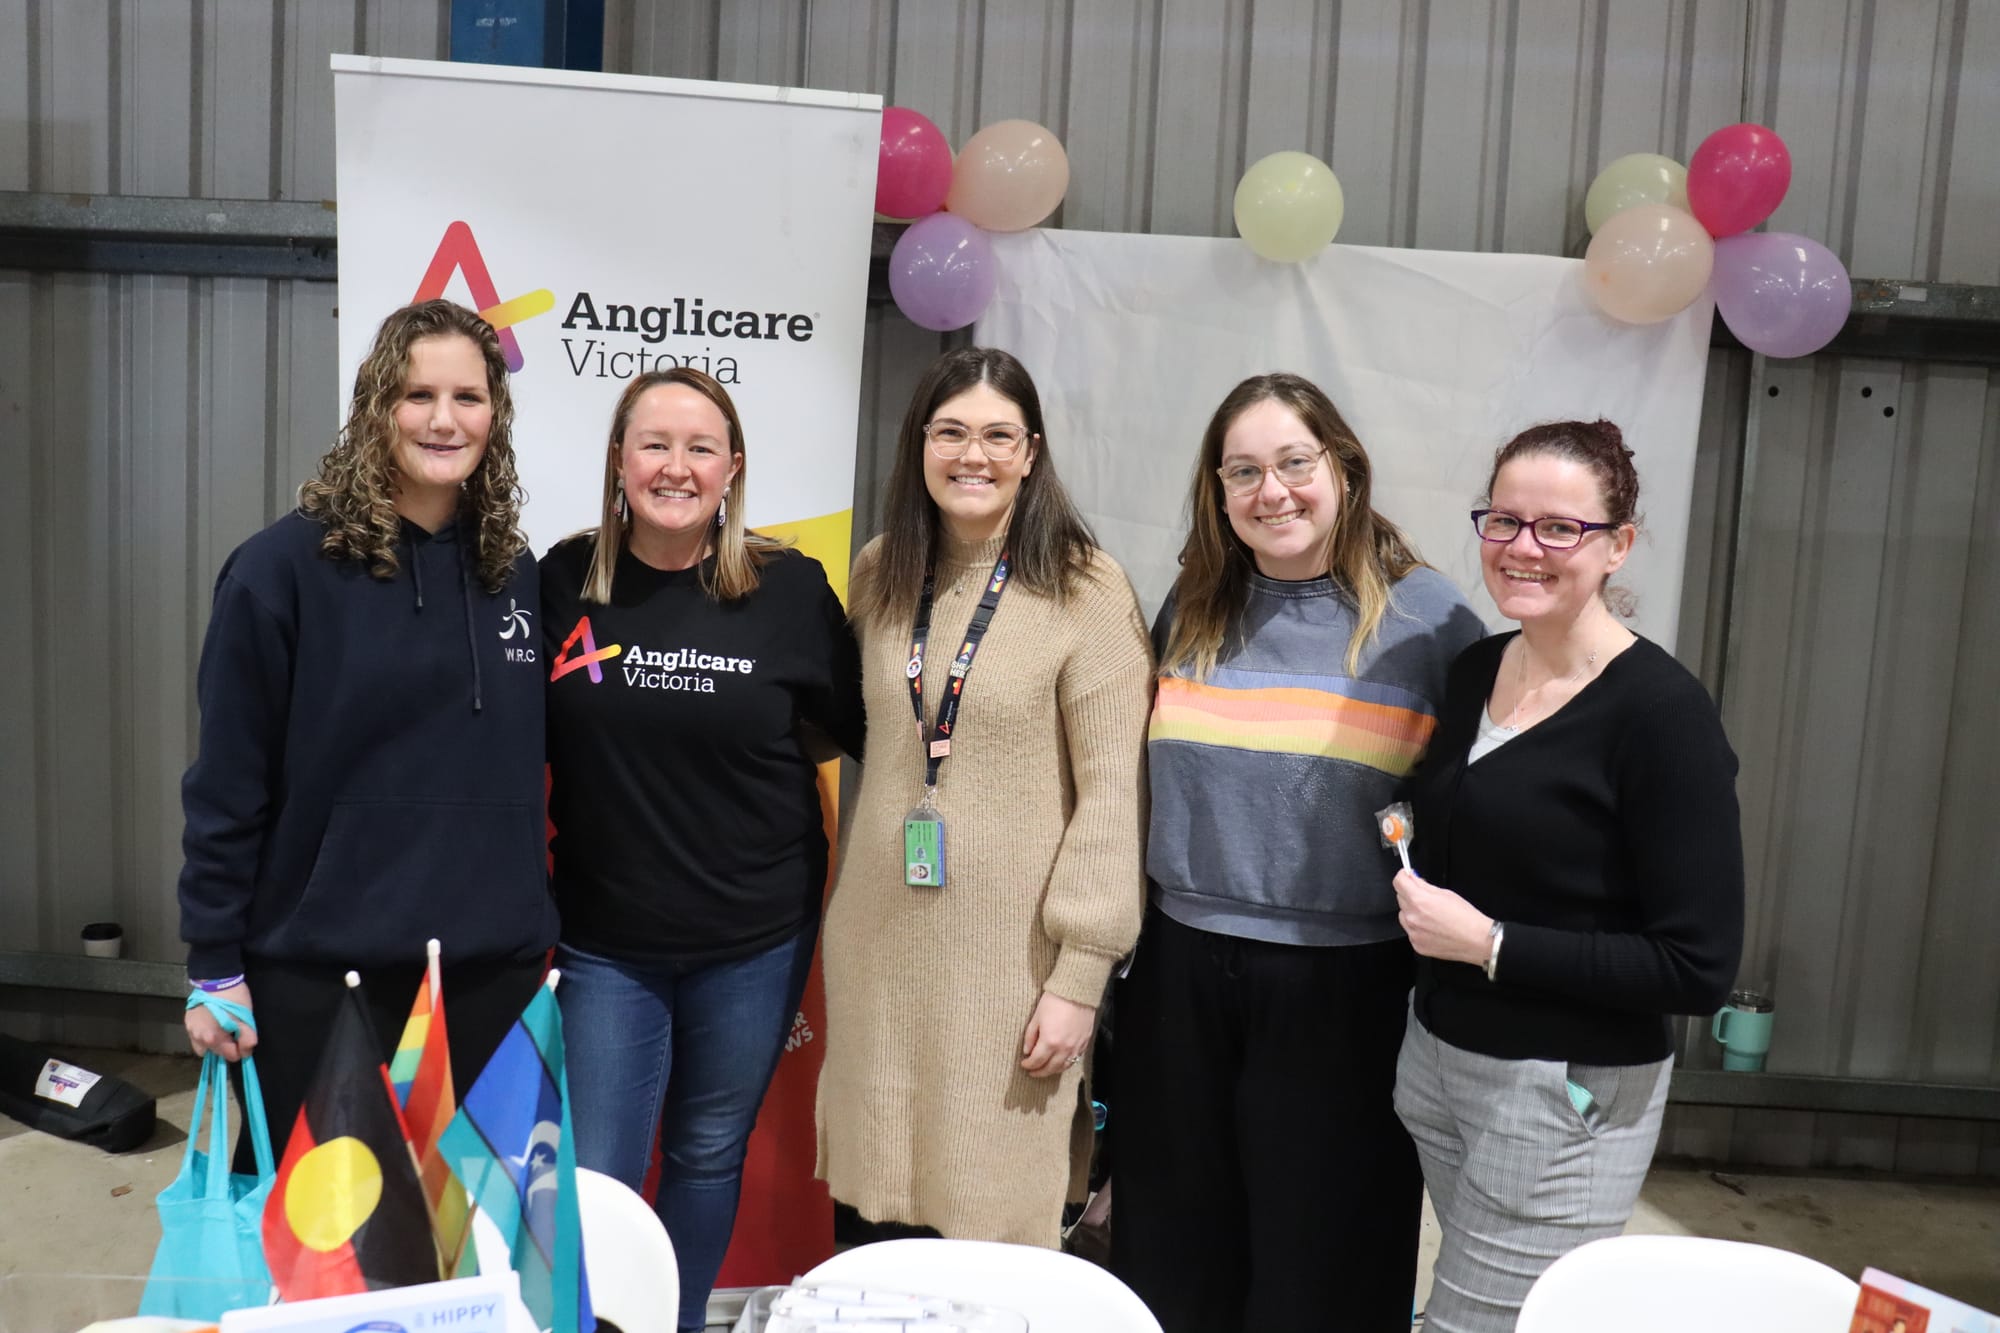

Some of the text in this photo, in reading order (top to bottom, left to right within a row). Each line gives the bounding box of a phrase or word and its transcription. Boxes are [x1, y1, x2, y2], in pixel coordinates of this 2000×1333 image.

[562, 292, 813, 343] Anglicare
[505, 647, 536, 663] W.R.C
[623, 645, 753, 674] Anglicare
[623, 667, 715, 693] Victoria
[949, 669, 966, 679] HER
[433, 1302, 496, 1326] HIPPY
